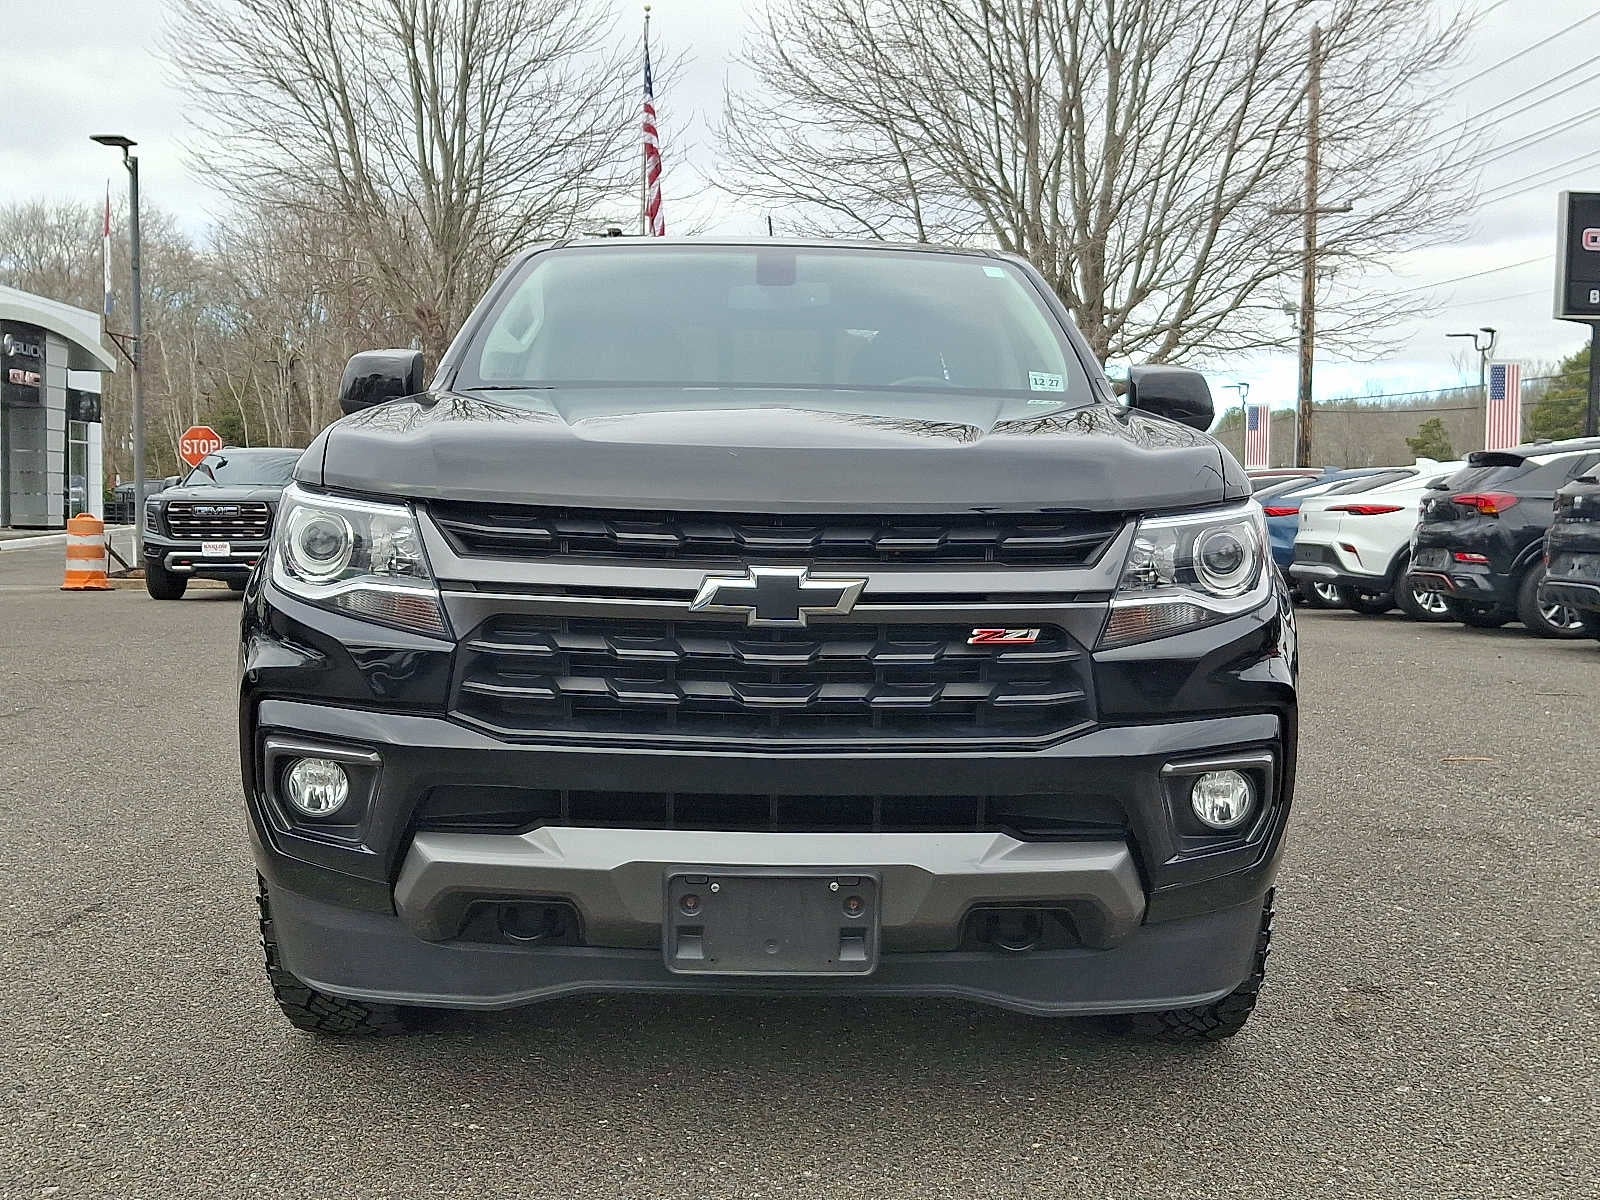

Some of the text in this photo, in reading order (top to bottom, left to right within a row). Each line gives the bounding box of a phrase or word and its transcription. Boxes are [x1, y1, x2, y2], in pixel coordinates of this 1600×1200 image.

[14, 341, 43, 358] BUICK
[1033, 377, 1059, 387] 12 27
[182, 439, 218, 455] STOP
[194, 506, 238, 516] GMC
[967, 628, 1040, 644] Z71
